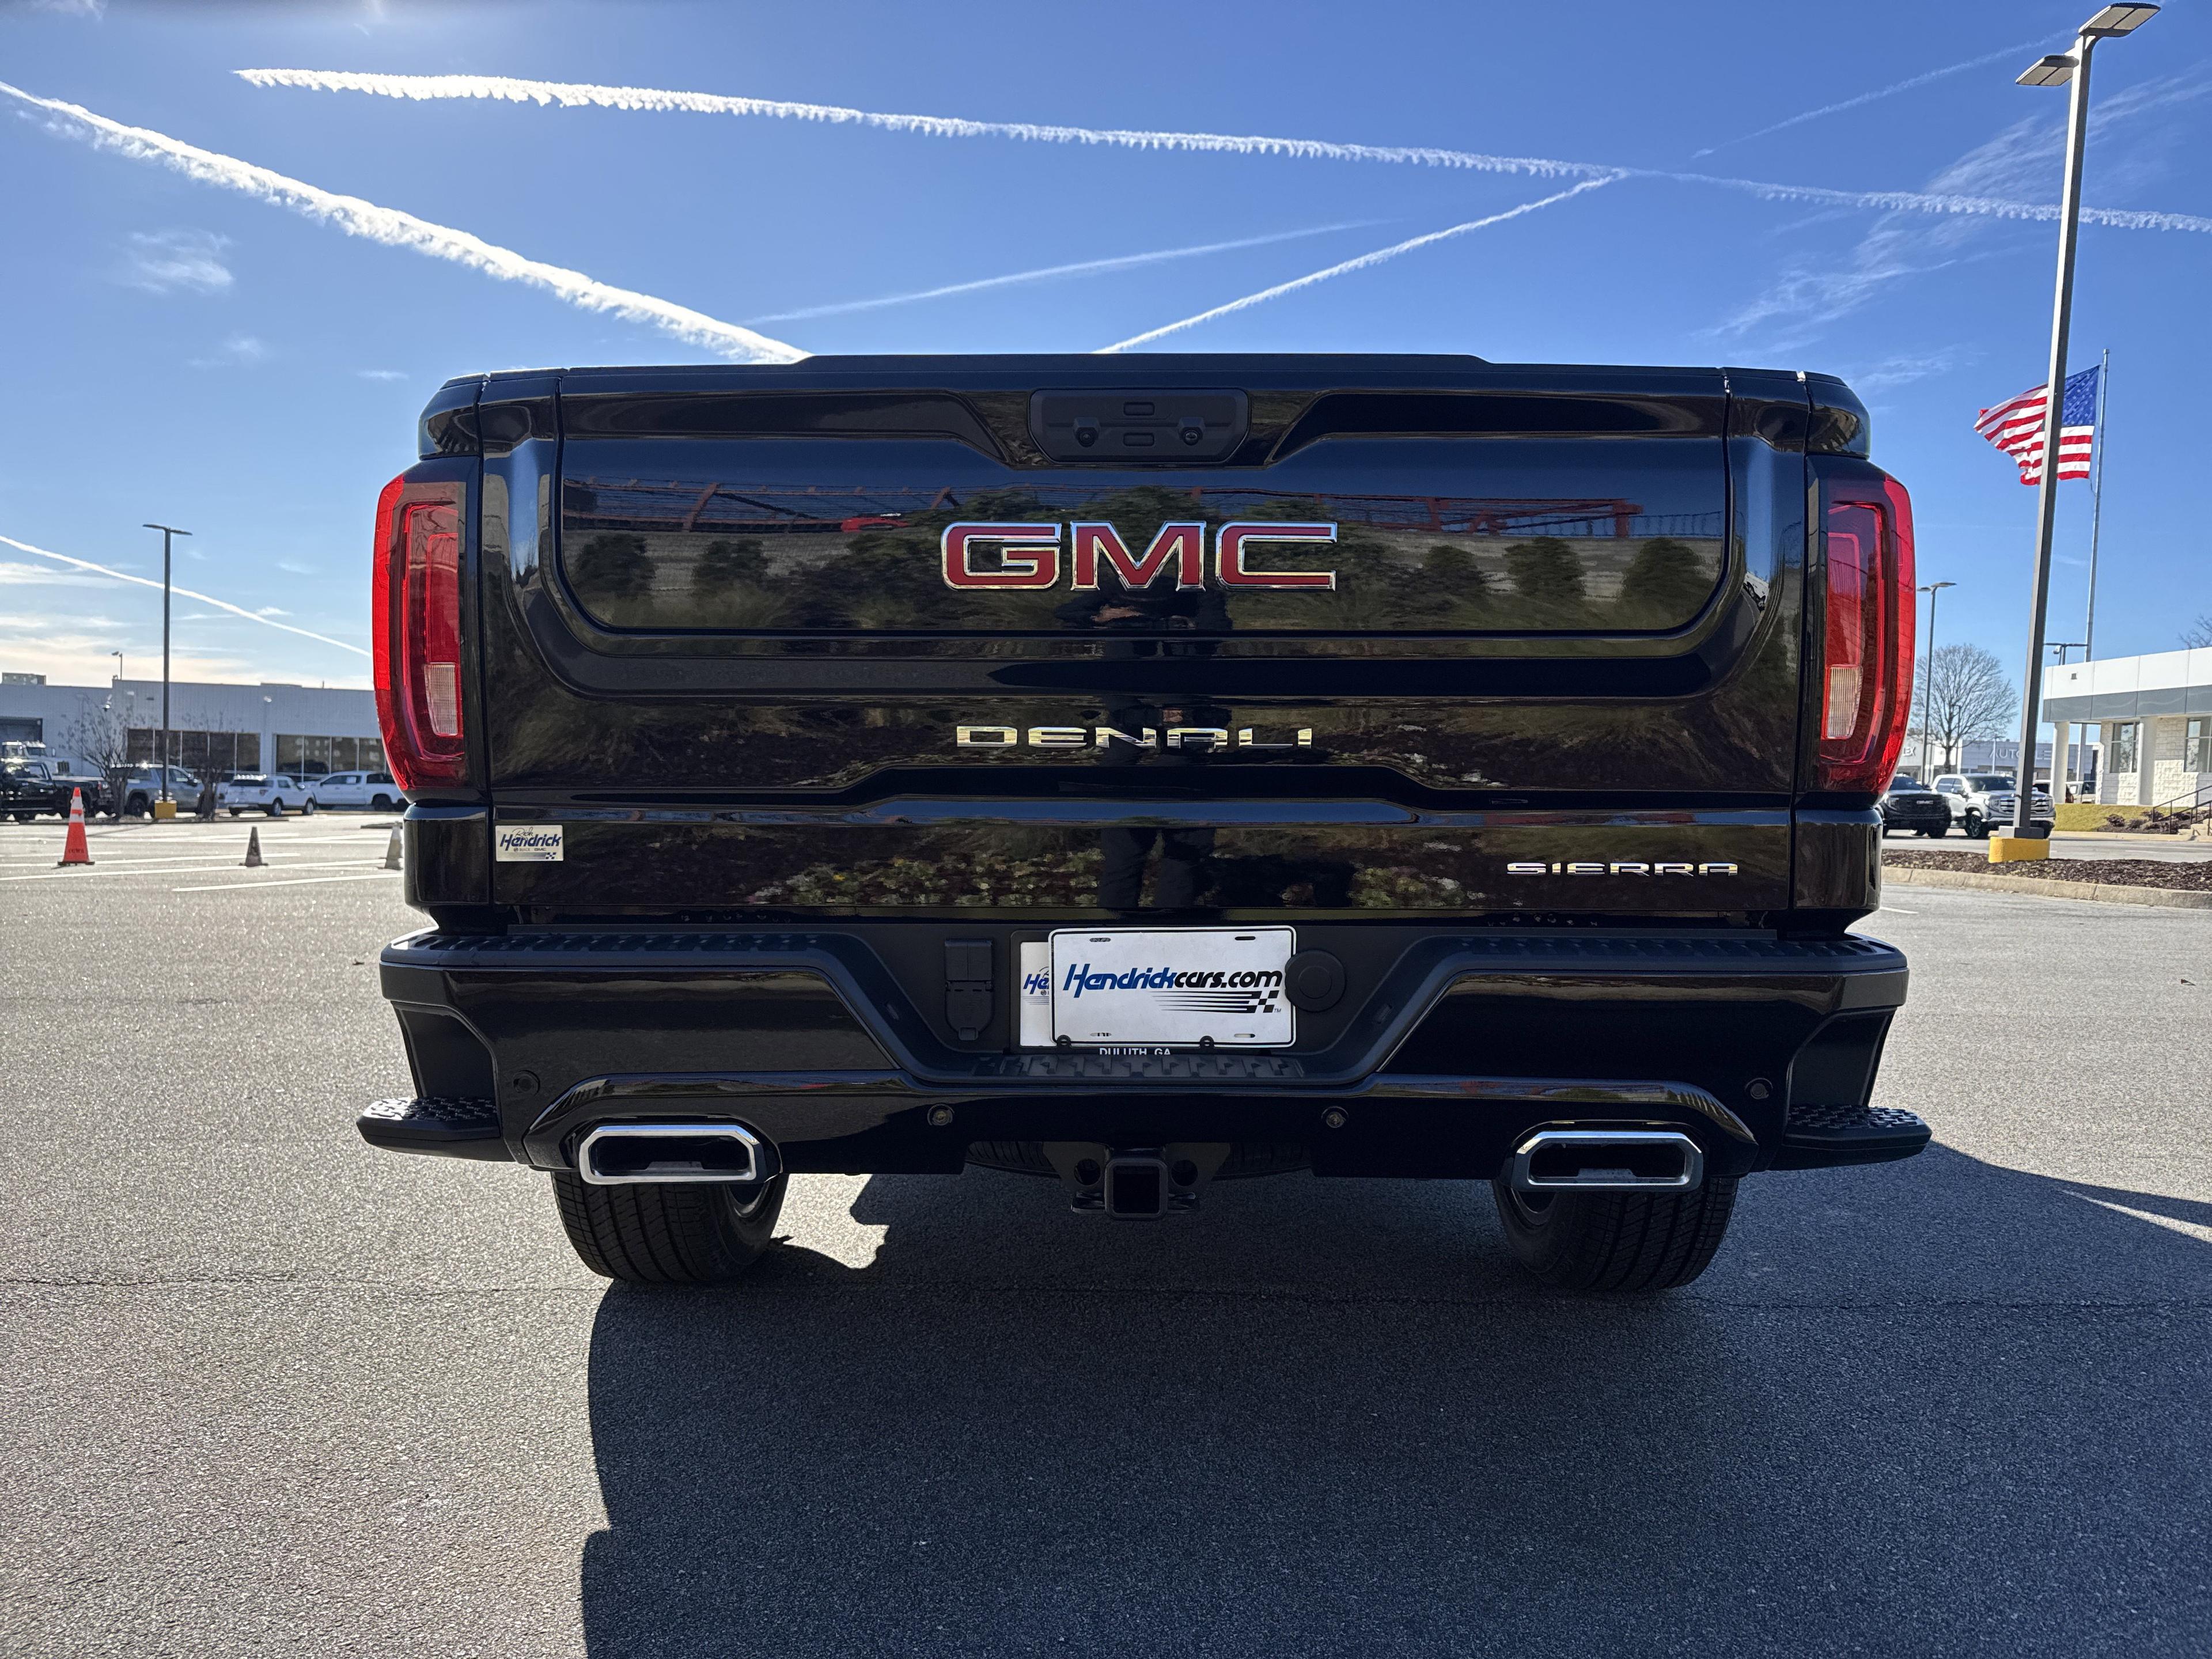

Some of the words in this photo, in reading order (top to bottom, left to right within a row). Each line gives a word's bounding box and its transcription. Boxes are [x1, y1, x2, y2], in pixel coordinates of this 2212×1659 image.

[941, 521, 1338, 590] GMC
[957, 726, 1312, 748] DENALI
[499, 834, 562, 851] Hendrick
[1507, 862, 1738, 876] SIERRA
[1063, 964, 1283, 998] Hendrickcars.com
